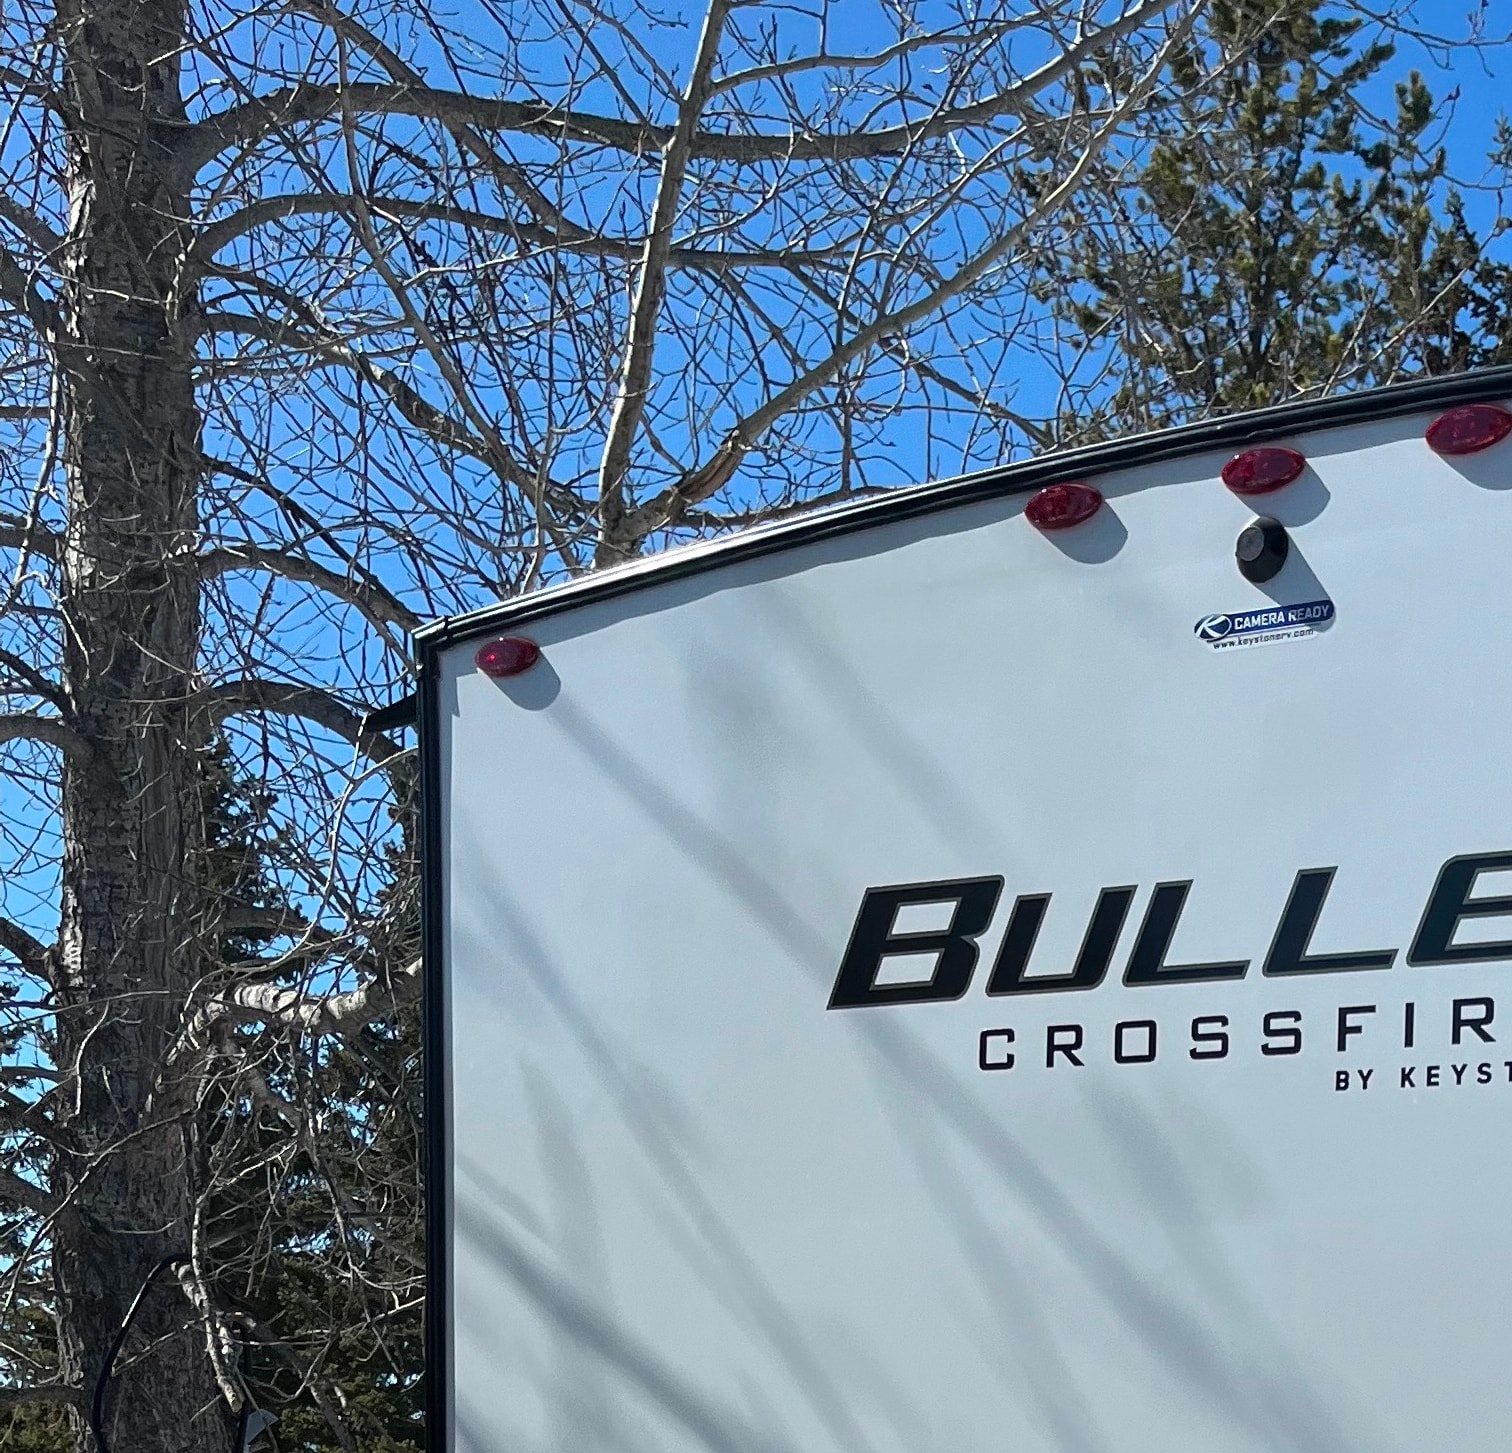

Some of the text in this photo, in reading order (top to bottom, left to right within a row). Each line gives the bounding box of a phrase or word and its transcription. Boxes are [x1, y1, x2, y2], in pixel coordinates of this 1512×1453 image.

[1234, 610, 1285, 630] CAMERA
[1288, 604, 1330, 622] READY
[1213, 628, 1314, 650] www.keystonerv.com
[1334, 1069, 1375, 1092] BY
